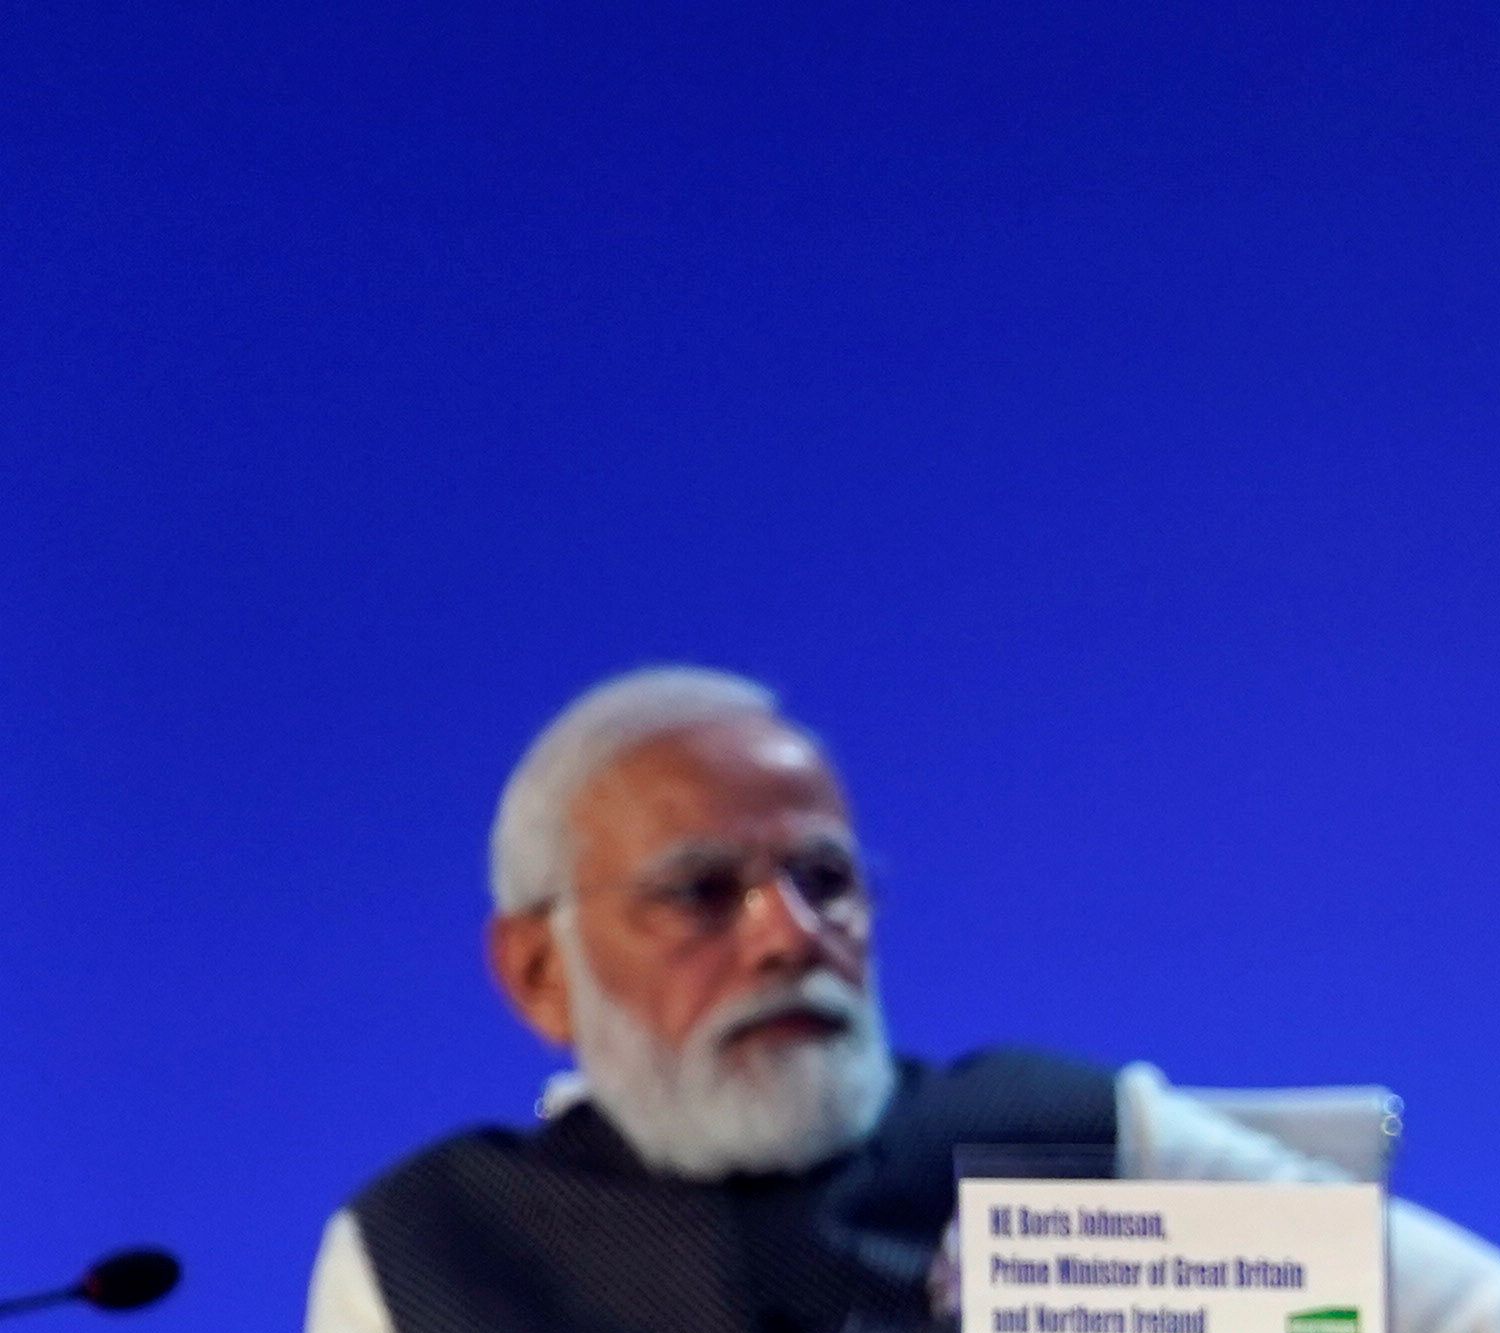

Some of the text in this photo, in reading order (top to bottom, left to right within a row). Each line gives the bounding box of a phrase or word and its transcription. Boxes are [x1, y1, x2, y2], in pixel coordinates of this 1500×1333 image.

[991, 1254, 1051, 1285] Prime
[1055, 1255, 1142, 1287] Minister
[1171, 1256, 1228, 1288] Great
[1233, 1257, 1305, 1289] Britain
[993, 1306, 1030, 1333] and
